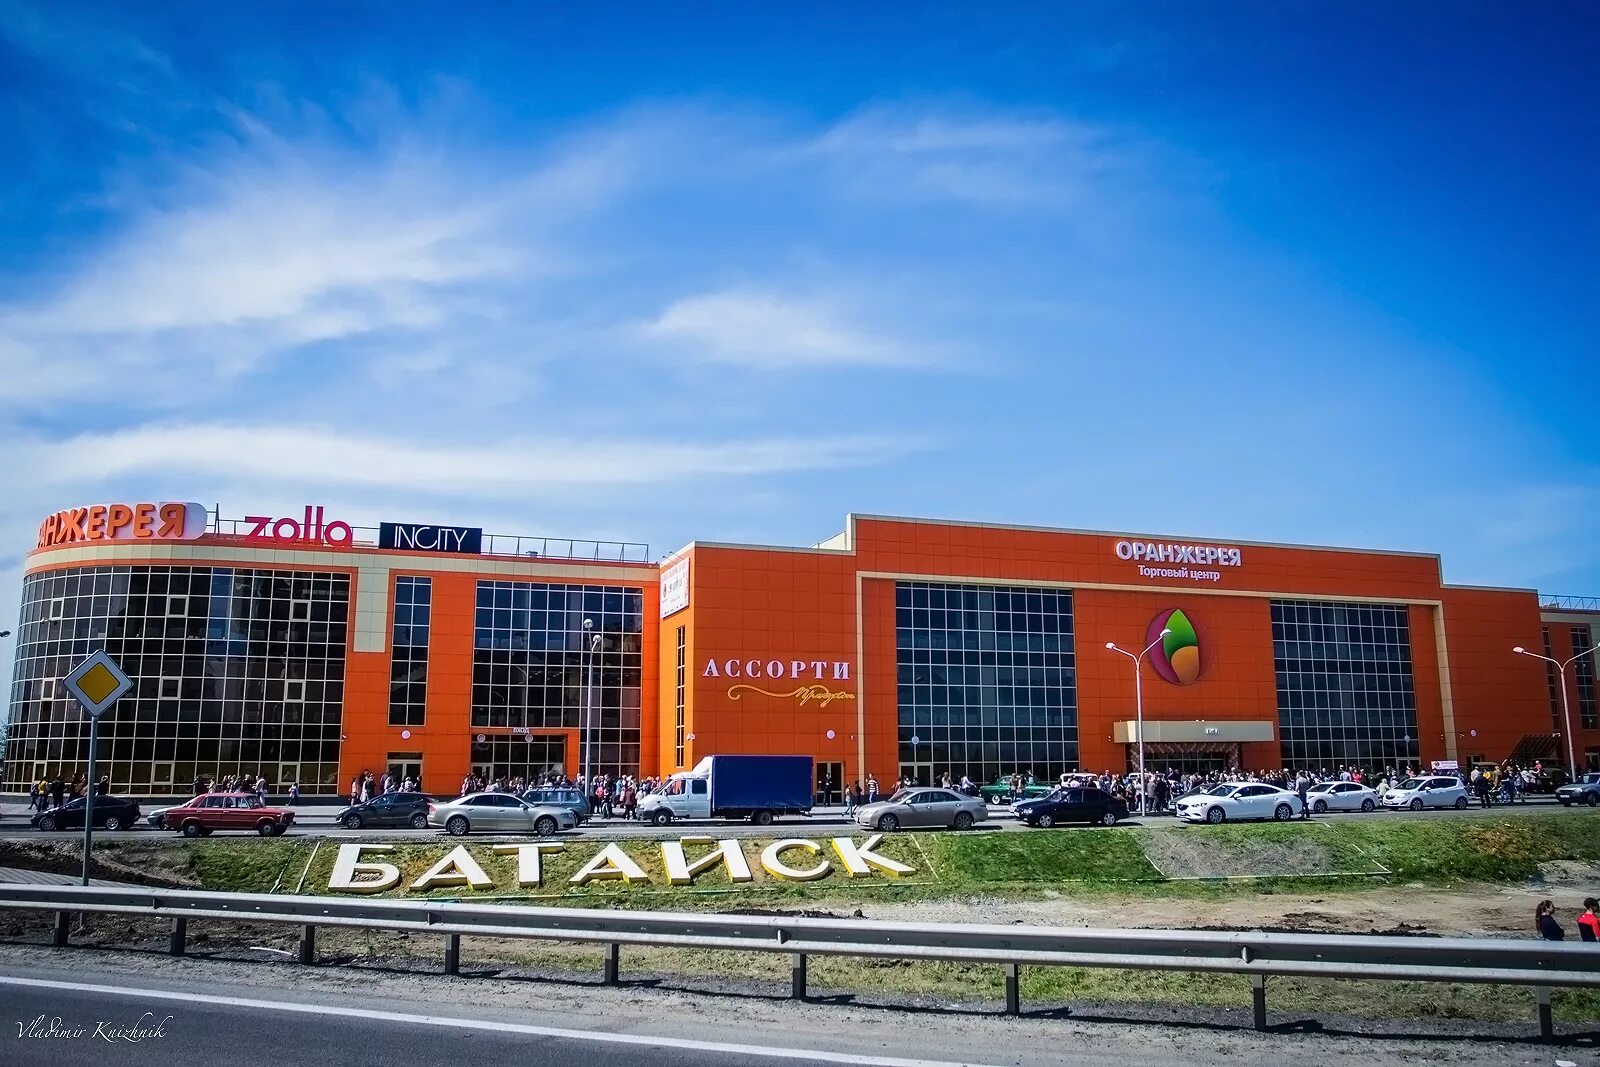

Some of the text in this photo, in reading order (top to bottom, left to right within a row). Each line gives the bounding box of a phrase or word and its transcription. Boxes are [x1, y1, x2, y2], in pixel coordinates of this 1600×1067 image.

[245, 505, 353, 547] zolla
[394, 525, 468, 551] INCITY
[1115, 541, 1242, 567] ОРАНЖЕРЕЯ
[1137, 565, 1221, 582] Торговый центр
[702, 658, 850, 680] АССОРТИ
[327, 833, 918, 893] БАТАЙСК
